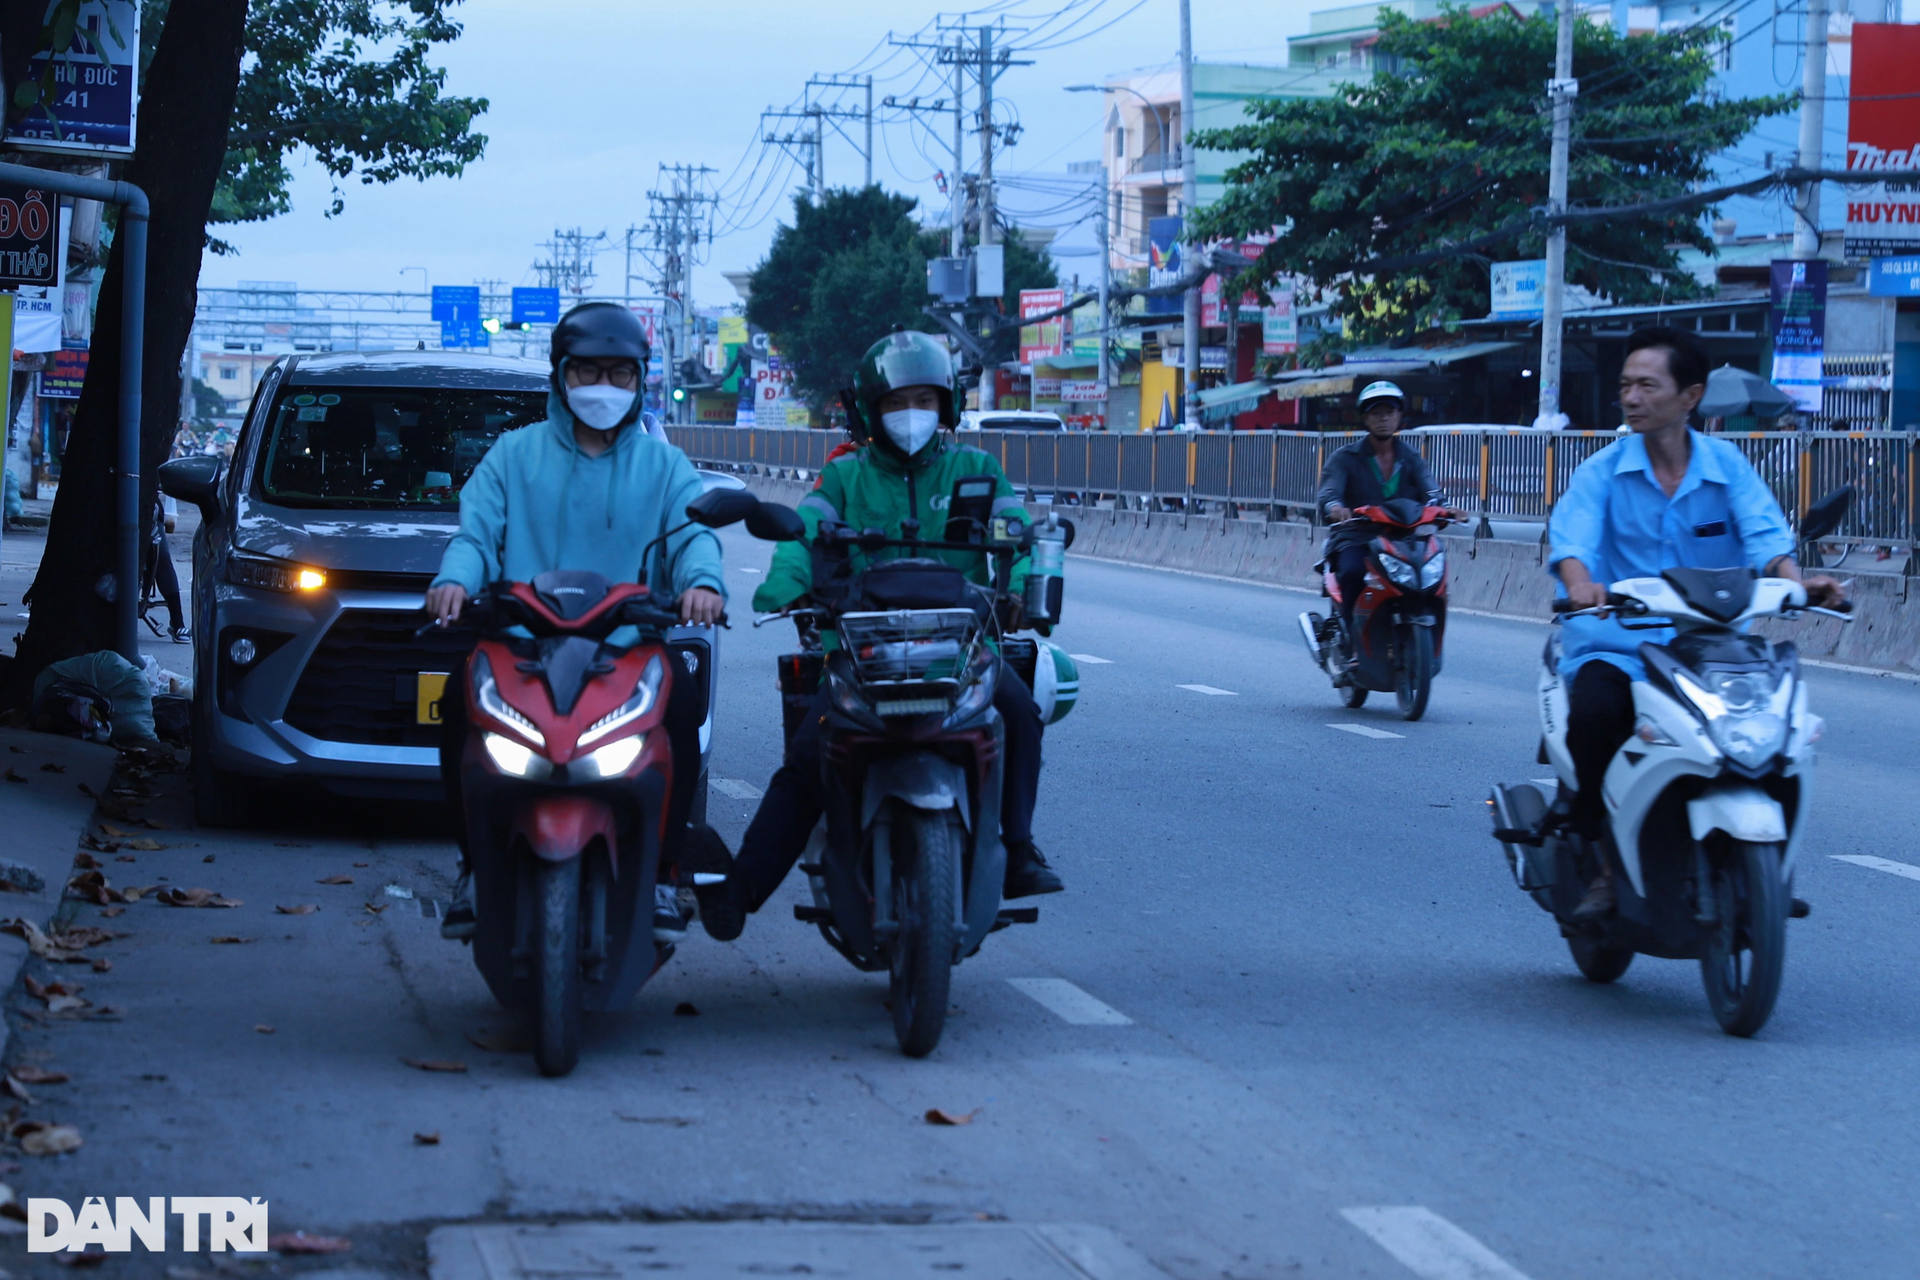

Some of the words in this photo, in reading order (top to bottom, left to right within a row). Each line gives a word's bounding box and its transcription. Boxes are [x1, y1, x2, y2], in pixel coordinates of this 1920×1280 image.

[7, 244, 49, 276] THẤP
[17, 301, 28, 312] TP.
[31, 302, 52, 312] HCM
